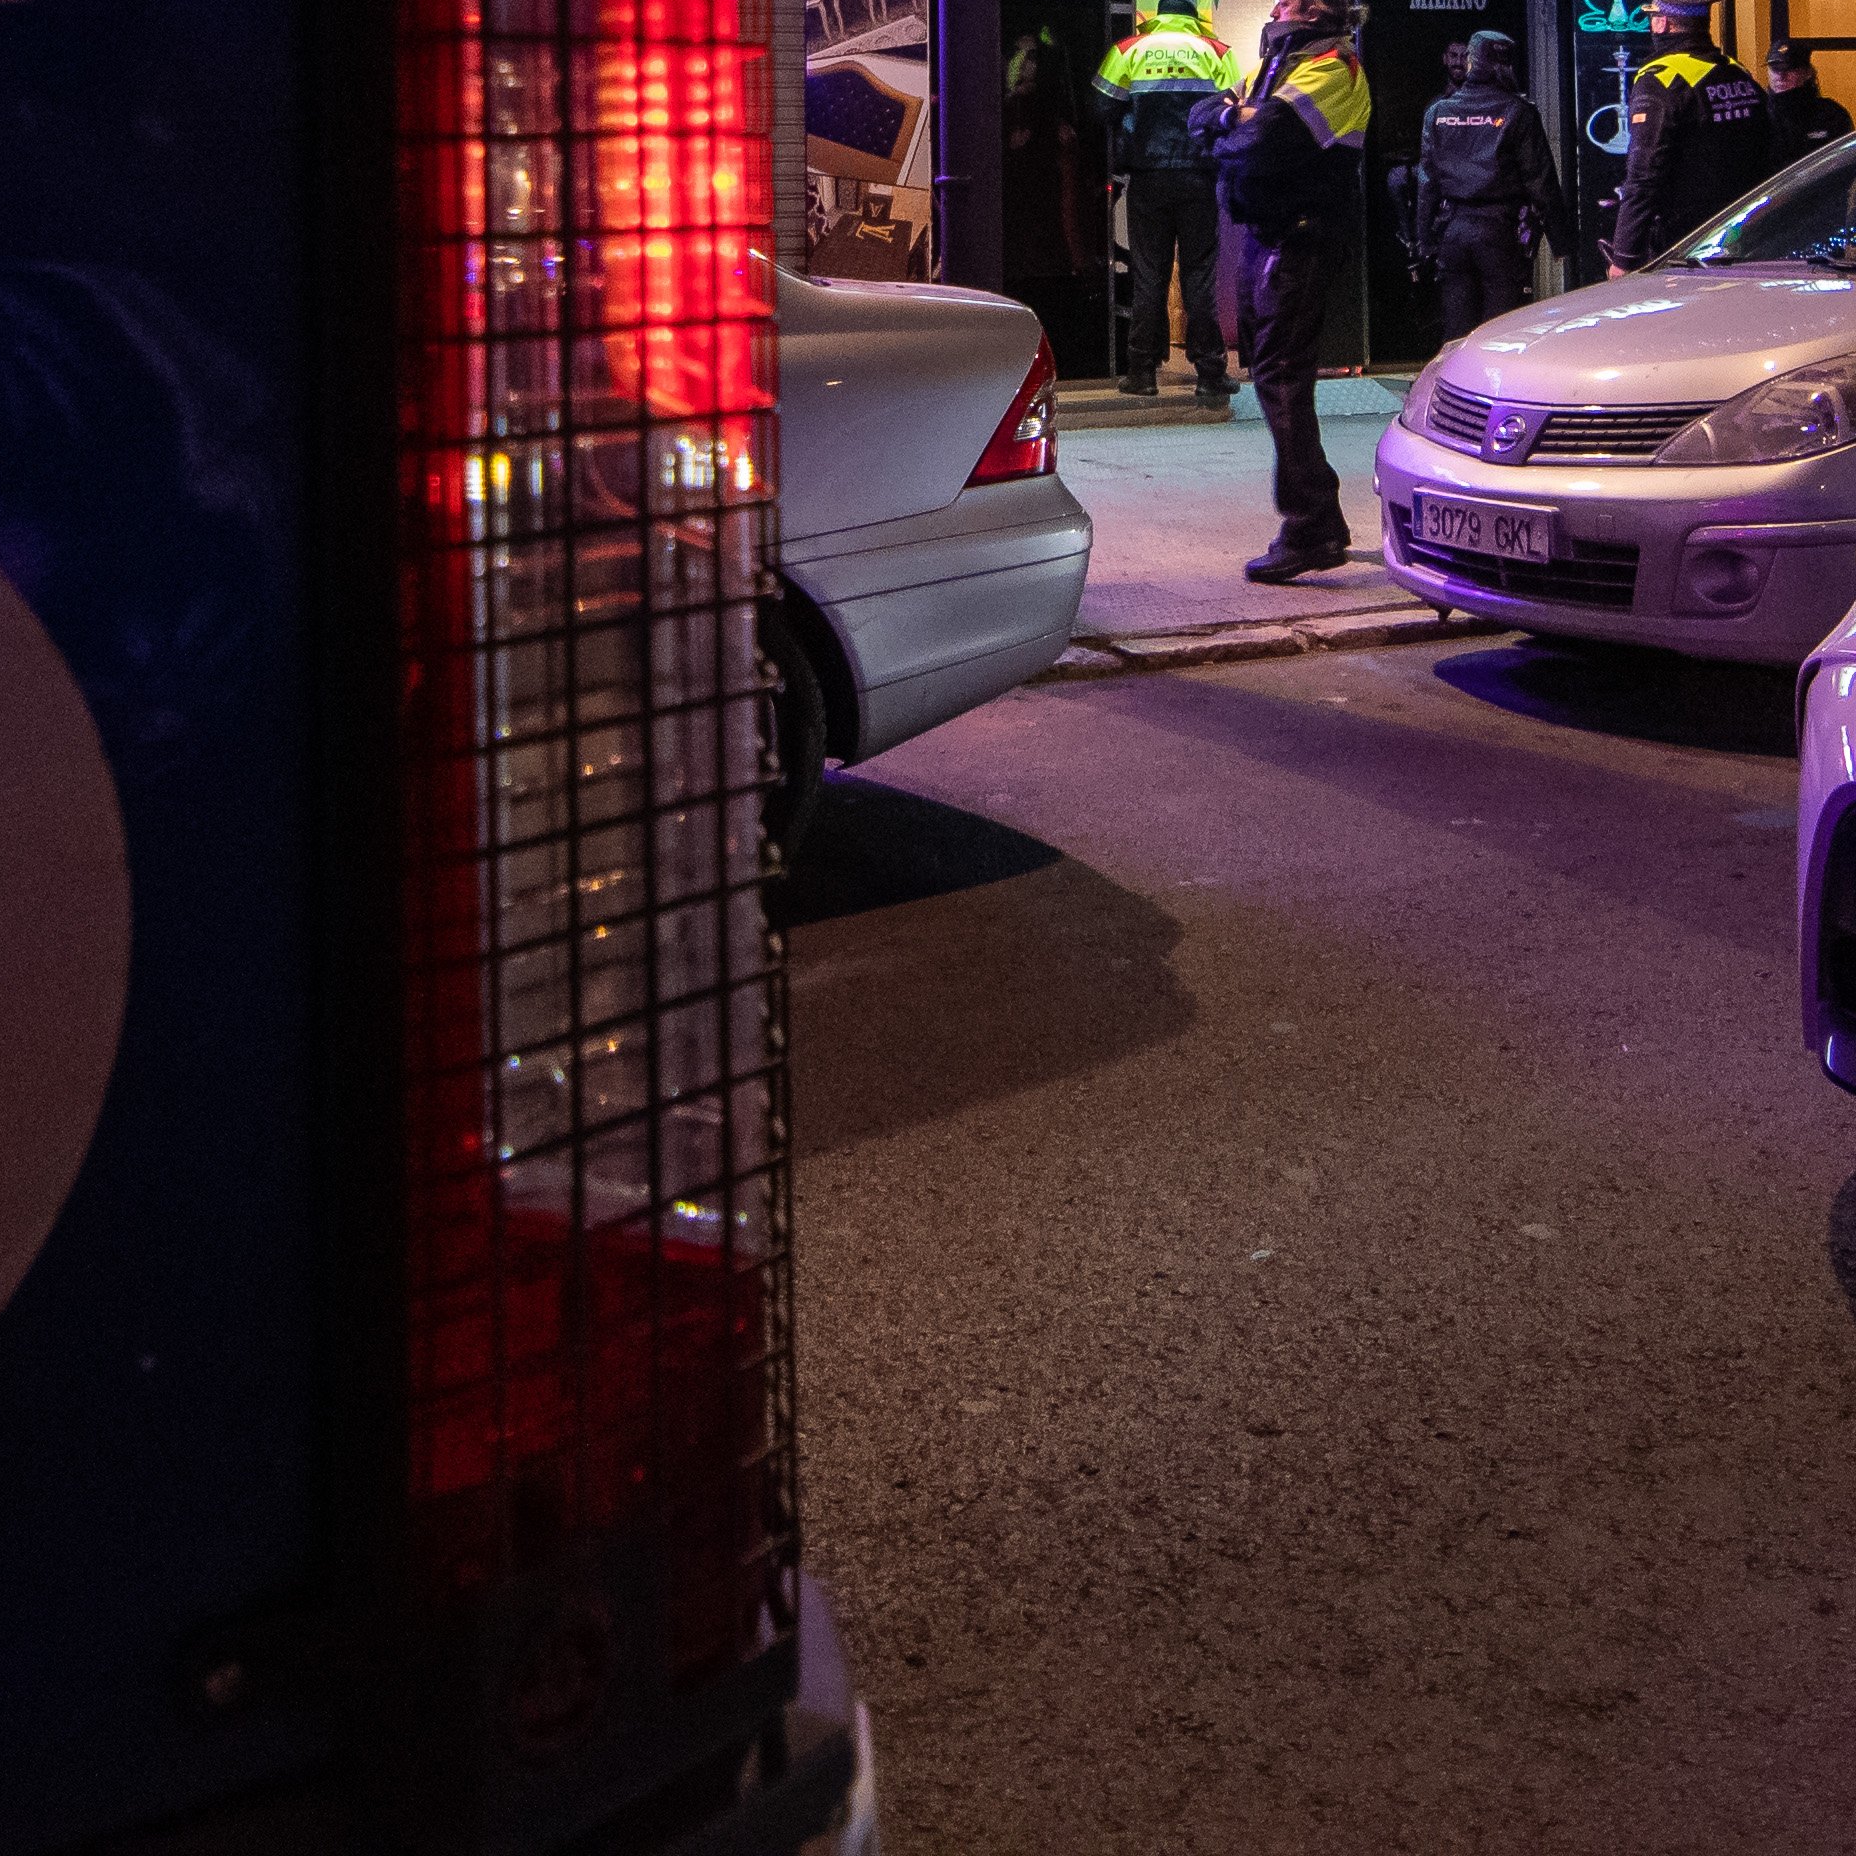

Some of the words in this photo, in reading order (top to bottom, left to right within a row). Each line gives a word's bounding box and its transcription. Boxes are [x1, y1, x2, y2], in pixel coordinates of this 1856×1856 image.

[1145, 49, 1200, 61] POLICIA
[1436, 116, 1494, 126] POLICIA
[1428, 503, 1482, 546] 3079
